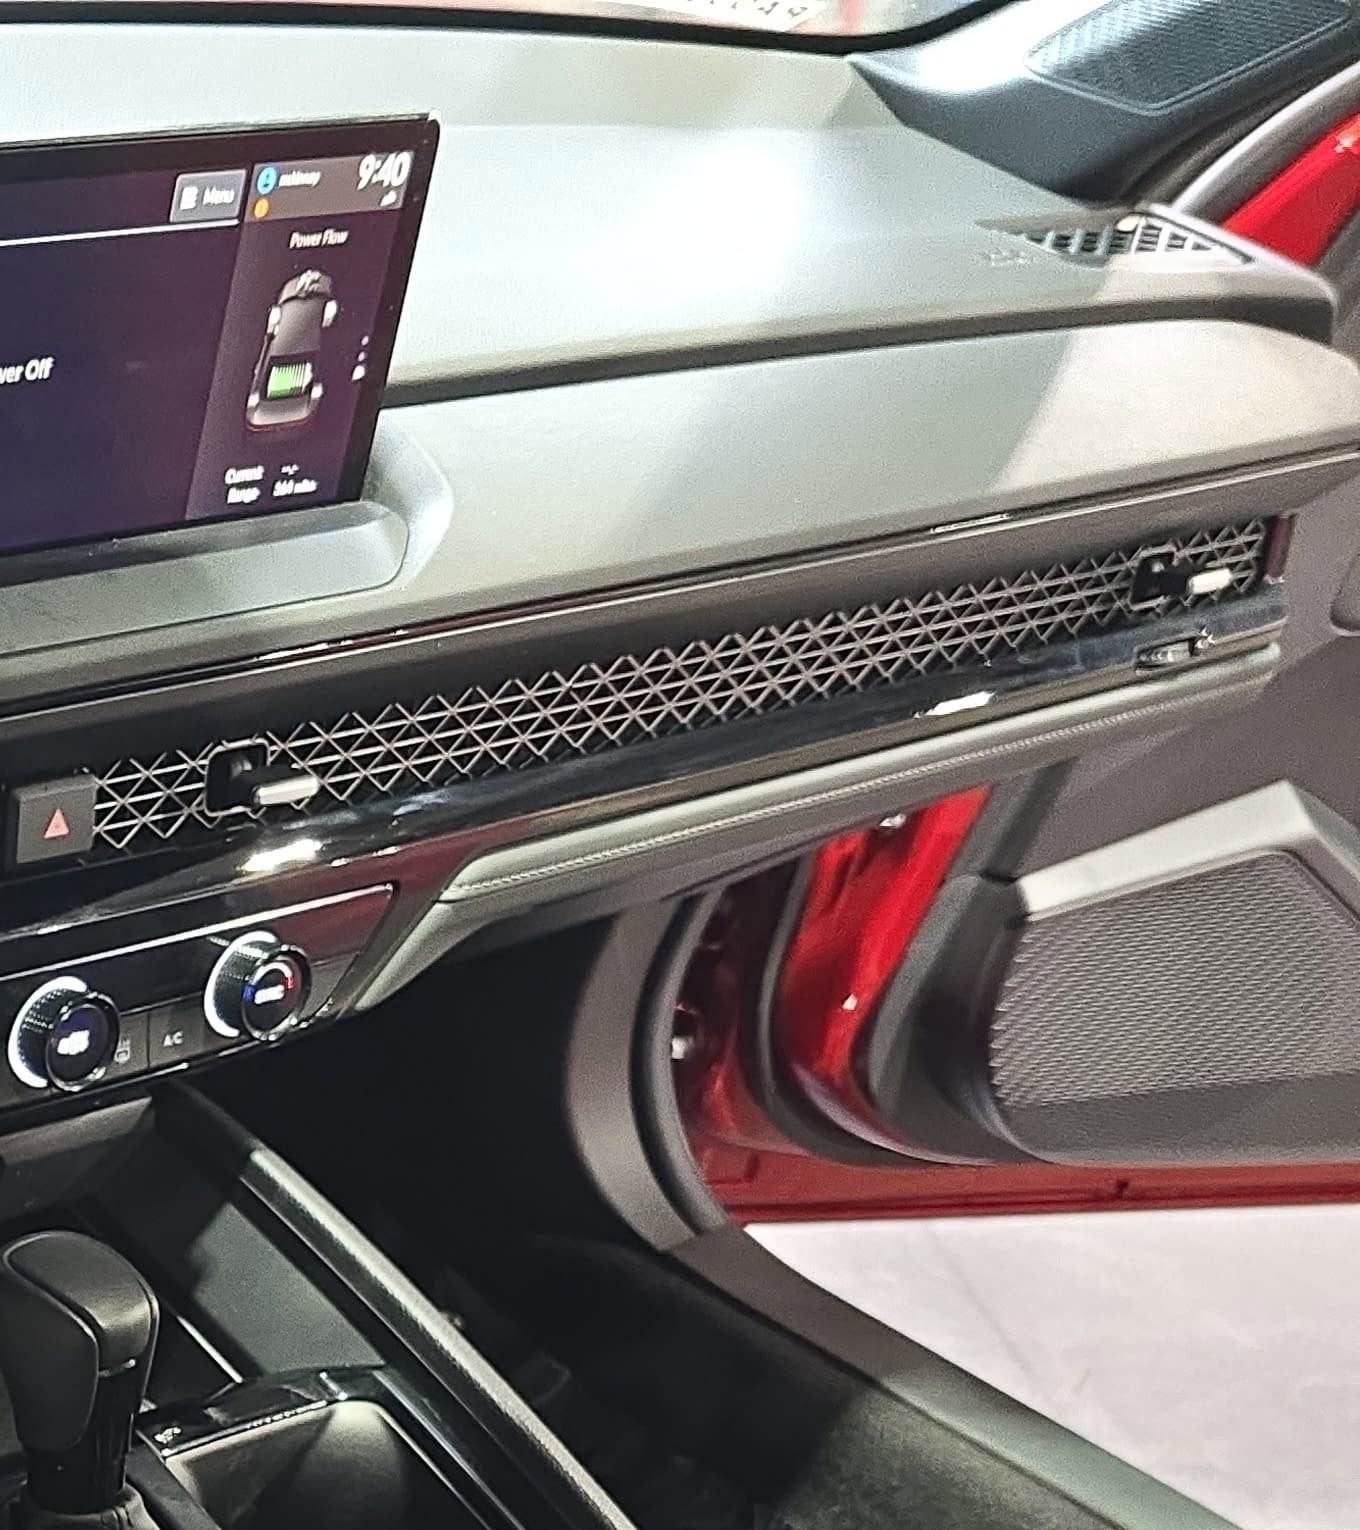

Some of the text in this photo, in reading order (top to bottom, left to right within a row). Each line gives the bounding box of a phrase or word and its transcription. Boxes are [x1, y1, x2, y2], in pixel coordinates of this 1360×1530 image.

[357, 151, 412, 190] 9:40
[289, 228, 349, 249] Power Flow
[25, 356, 55, 381] Off
